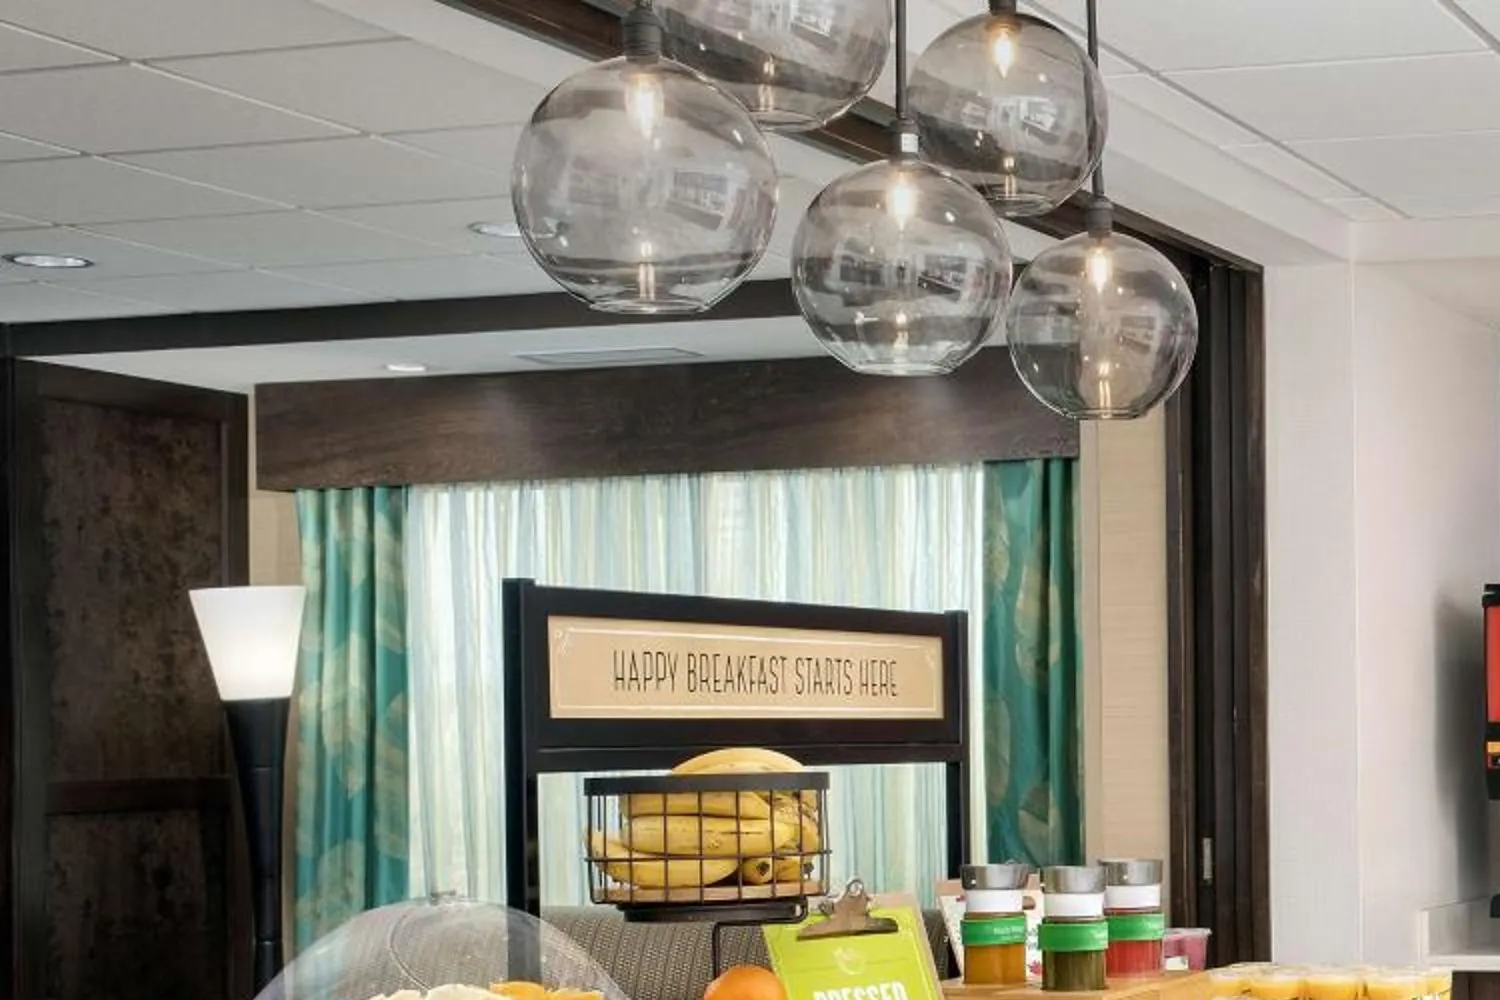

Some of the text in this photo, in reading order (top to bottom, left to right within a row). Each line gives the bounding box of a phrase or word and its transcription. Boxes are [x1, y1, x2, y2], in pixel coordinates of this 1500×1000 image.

[612, 651, 898, 698] HAPPY BREAKFAST STARTS HERE
